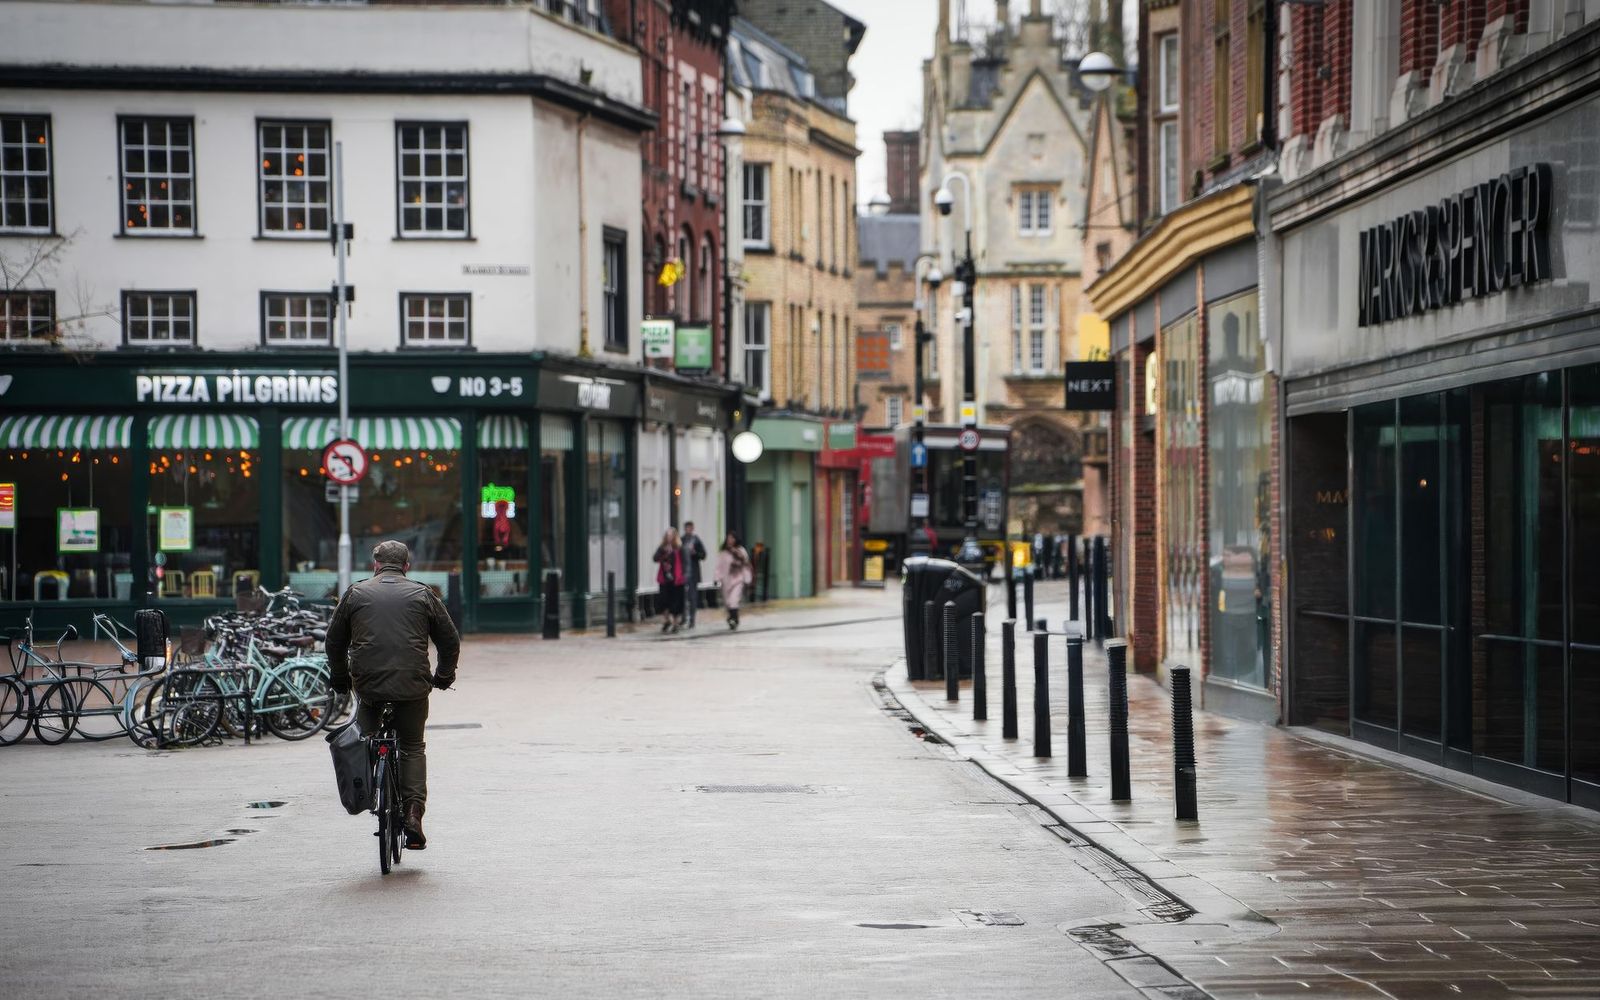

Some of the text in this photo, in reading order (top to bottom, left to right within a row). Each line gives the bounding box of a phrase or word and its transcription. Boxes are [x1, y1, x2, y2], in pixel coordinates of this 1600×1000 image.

[136, 375, 210, 402] PIZZA
[460, 376, 523, 397] NO 3-5
[1067, 378, 1112, 393] NEXT
